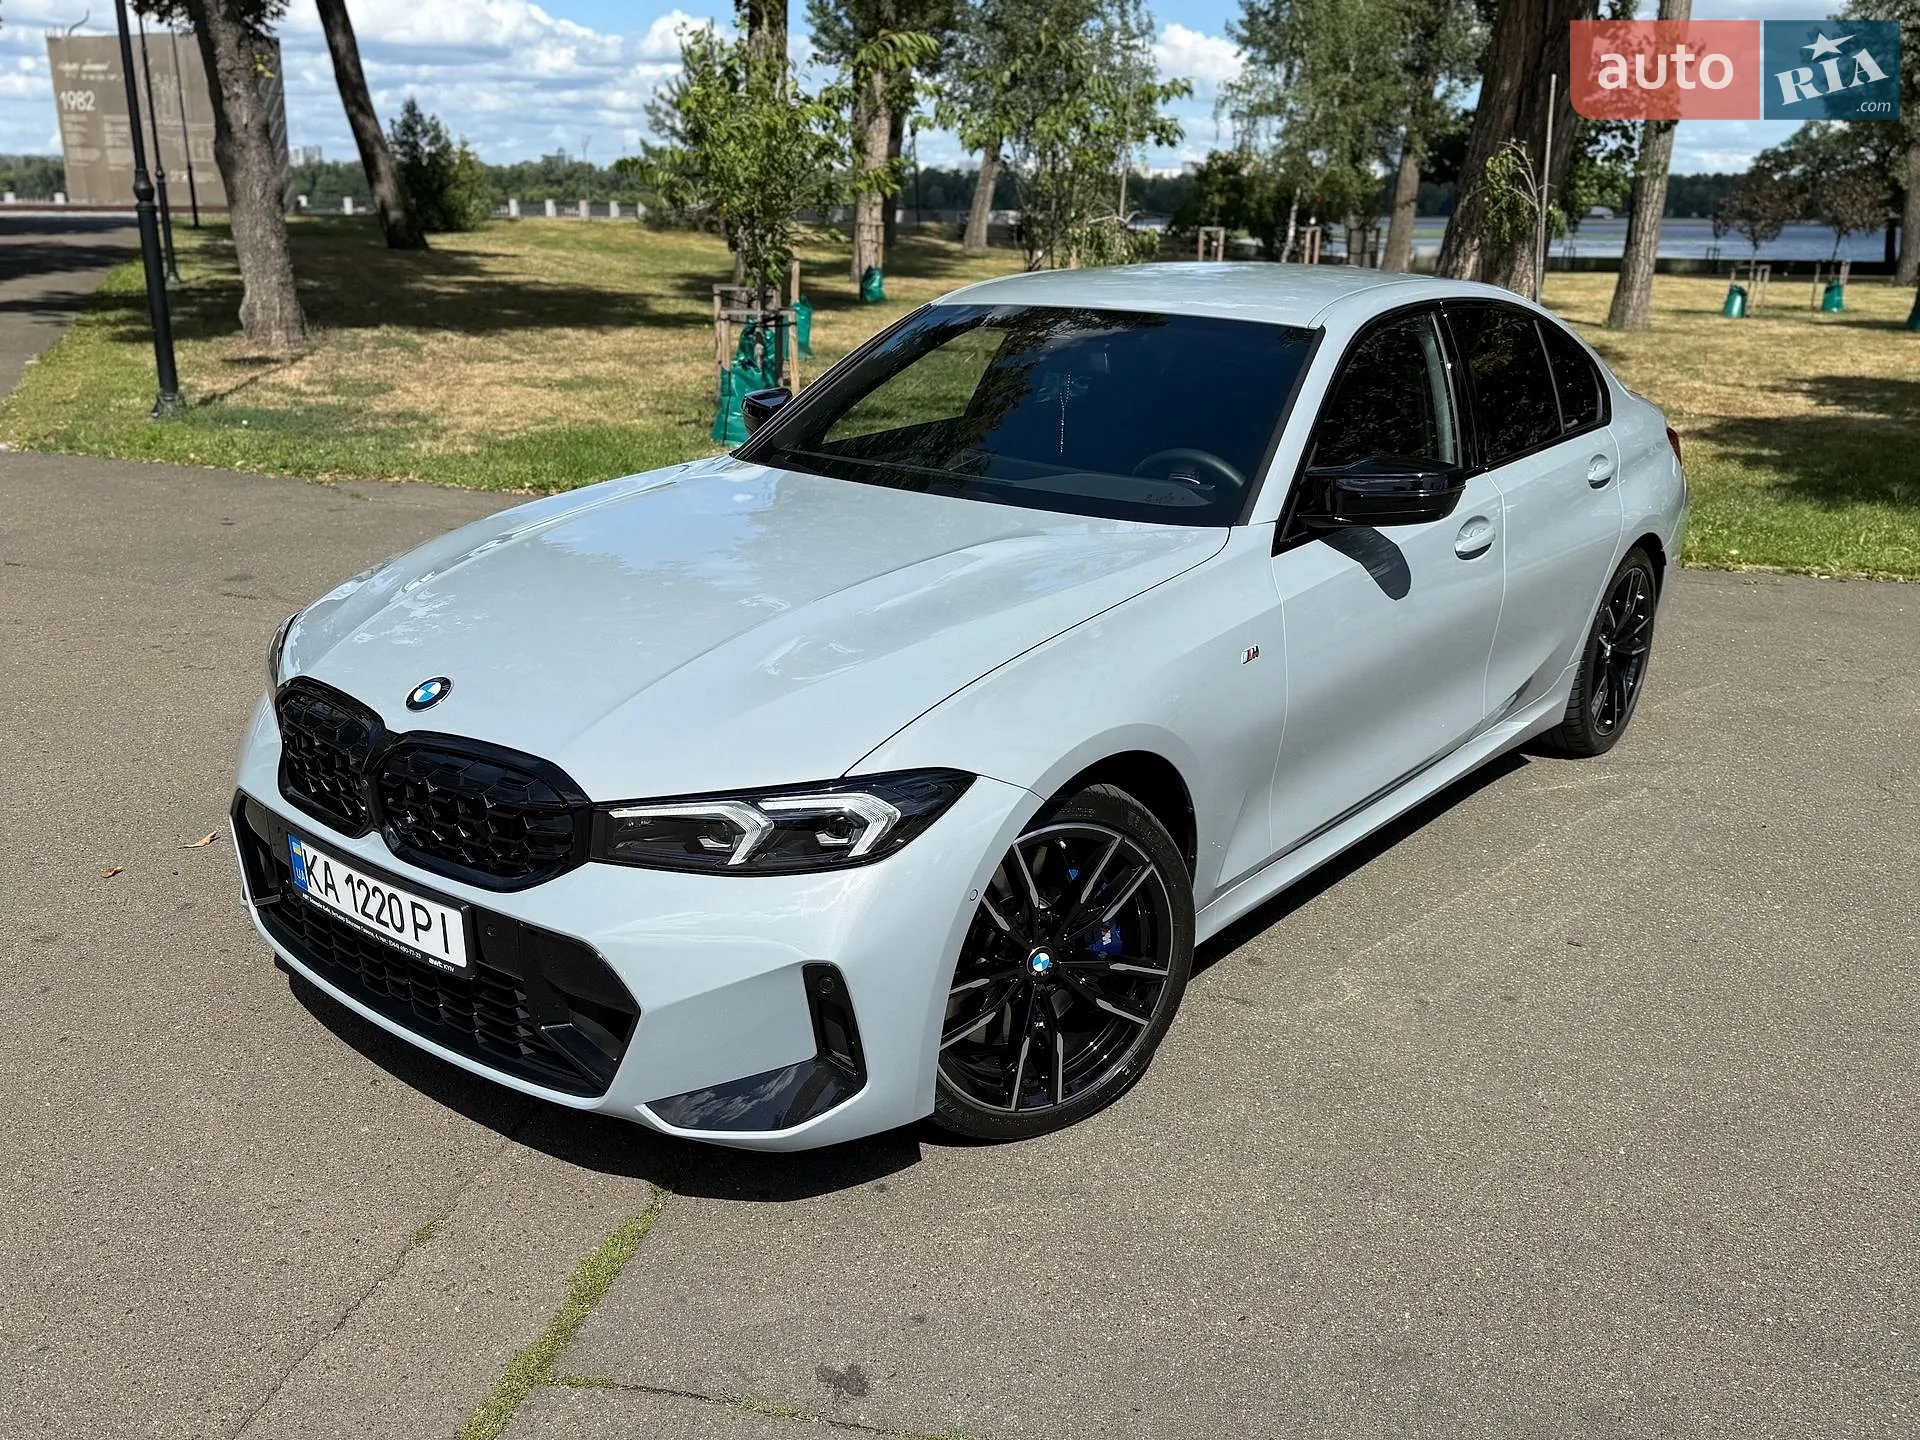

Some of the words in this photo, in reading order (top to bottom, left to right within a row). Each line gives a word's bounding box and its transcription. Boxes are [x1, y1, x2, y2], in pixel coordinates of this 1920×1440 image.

[60, 89, 96, 112] 1982
[296, 866, 306, 883] UA
[303, 848, 341, 904] KA
[344, 873, 405, 934] 1220
